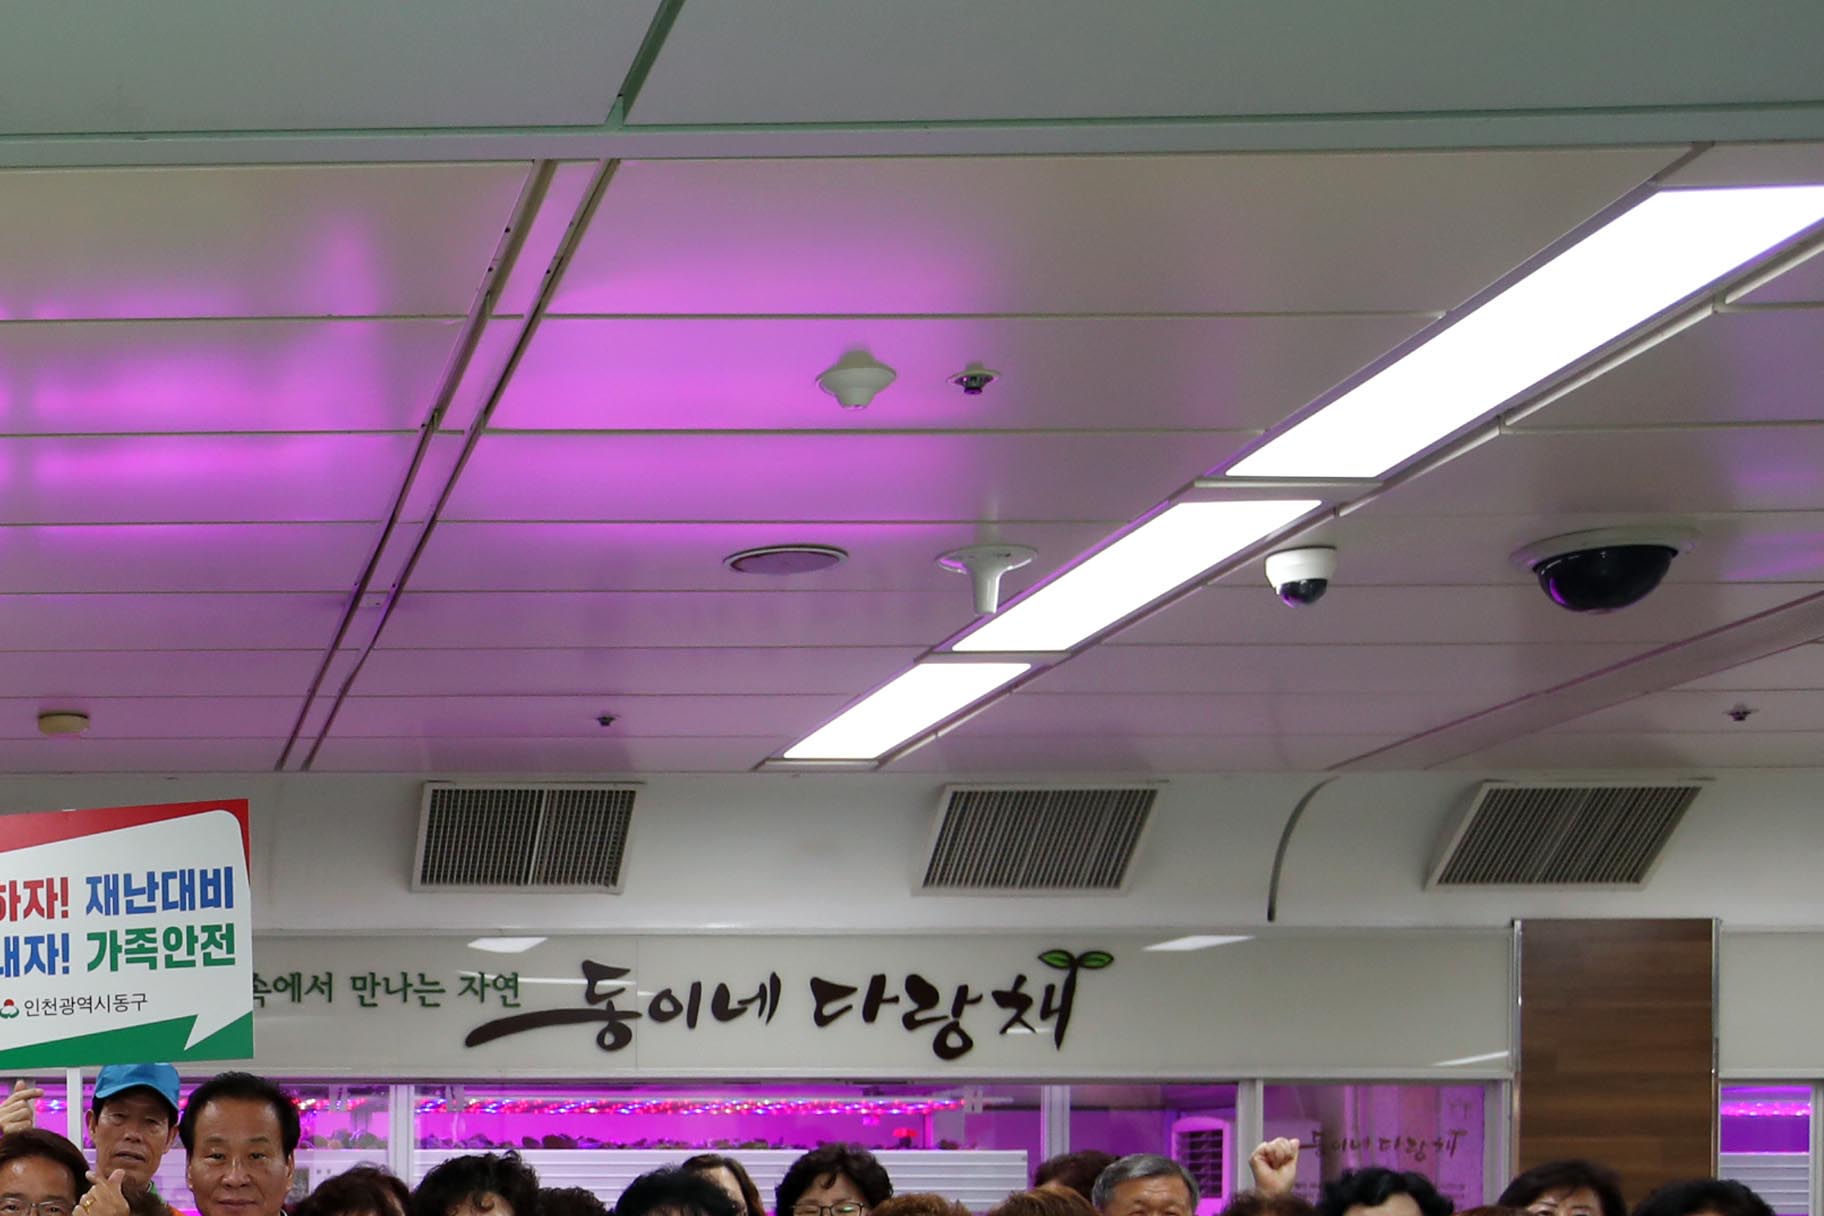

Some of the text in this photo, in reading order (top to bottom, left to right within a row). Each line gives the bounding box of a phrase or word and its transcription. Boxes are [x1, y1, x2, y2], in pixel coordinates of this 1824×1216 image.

[85, 866, 234, 916] 재난대비
[85, 922, 237, 972] 가족안전
[23, 992, 149, 1017] 인천광역시동구
[350, 971, 446, 1008] 만나는
[457, 971, 521, 1008] 자연
[464, 954, 1081, 1061] 동이네 다랑채
